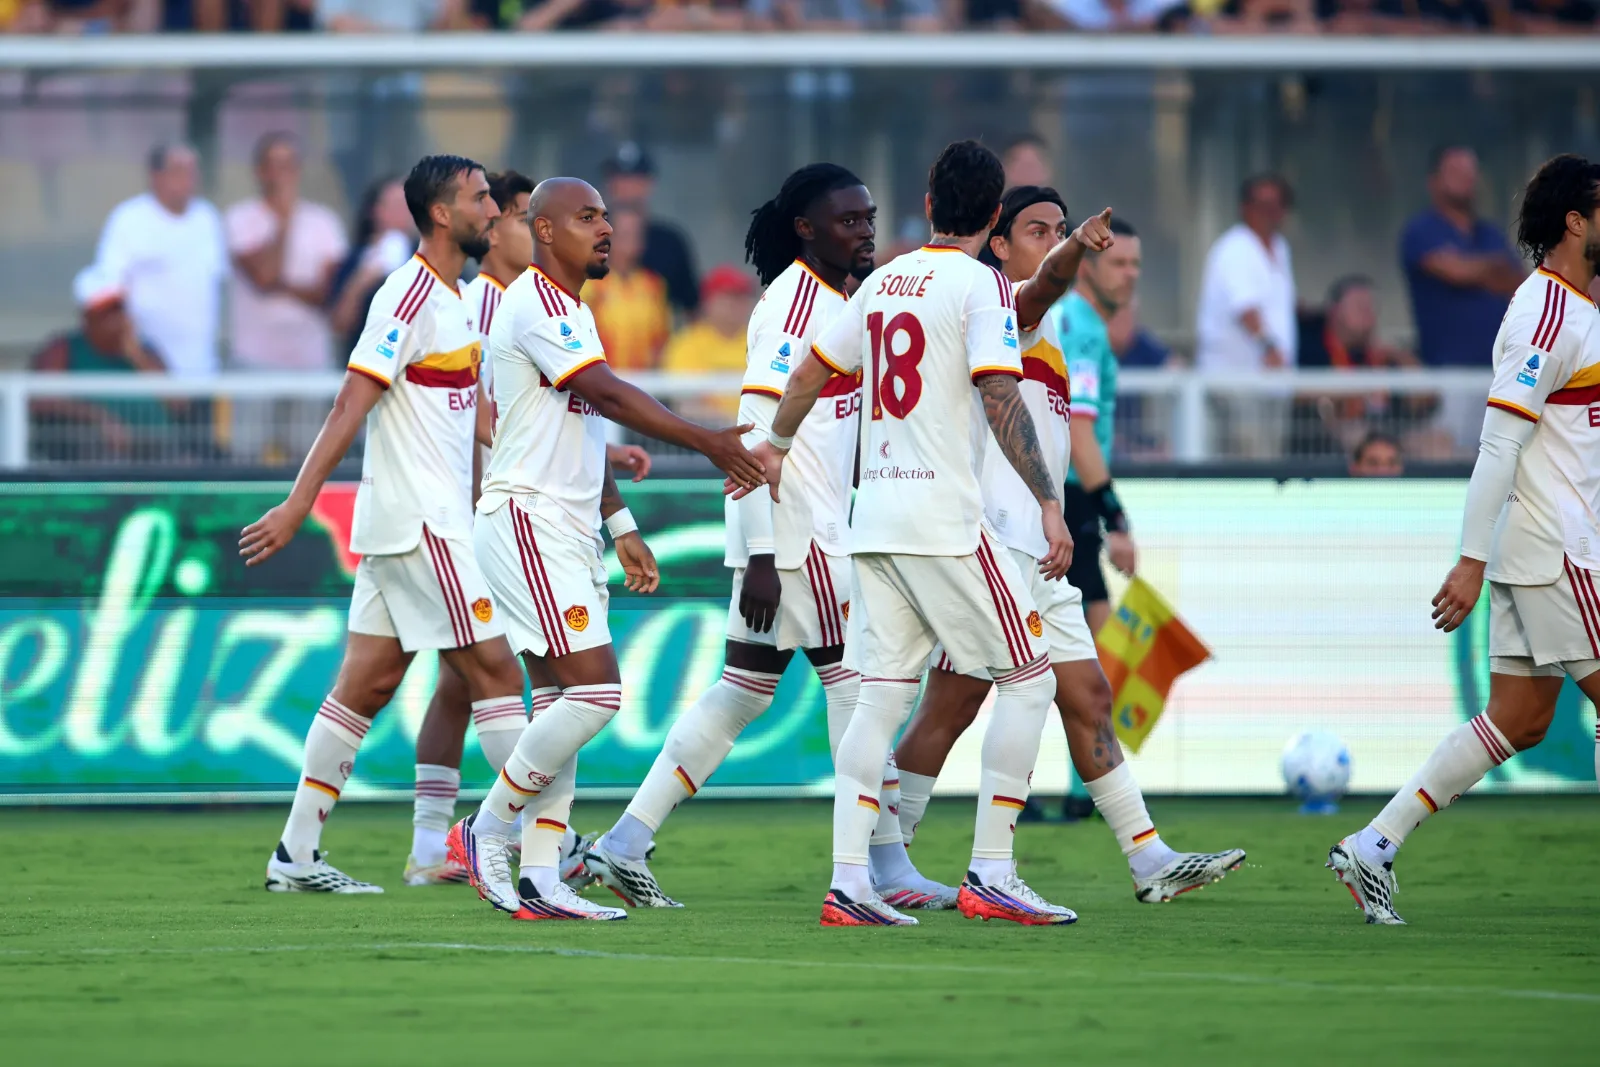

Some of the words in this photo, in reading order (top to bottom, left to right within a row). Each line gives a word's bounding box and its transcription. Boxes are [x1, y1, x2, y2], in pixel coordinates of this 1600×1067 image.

[876, 270, 935, 298] SOULÉ
[866, 311, 926, 421] 18
[880, 466, 935, 480] Collection
